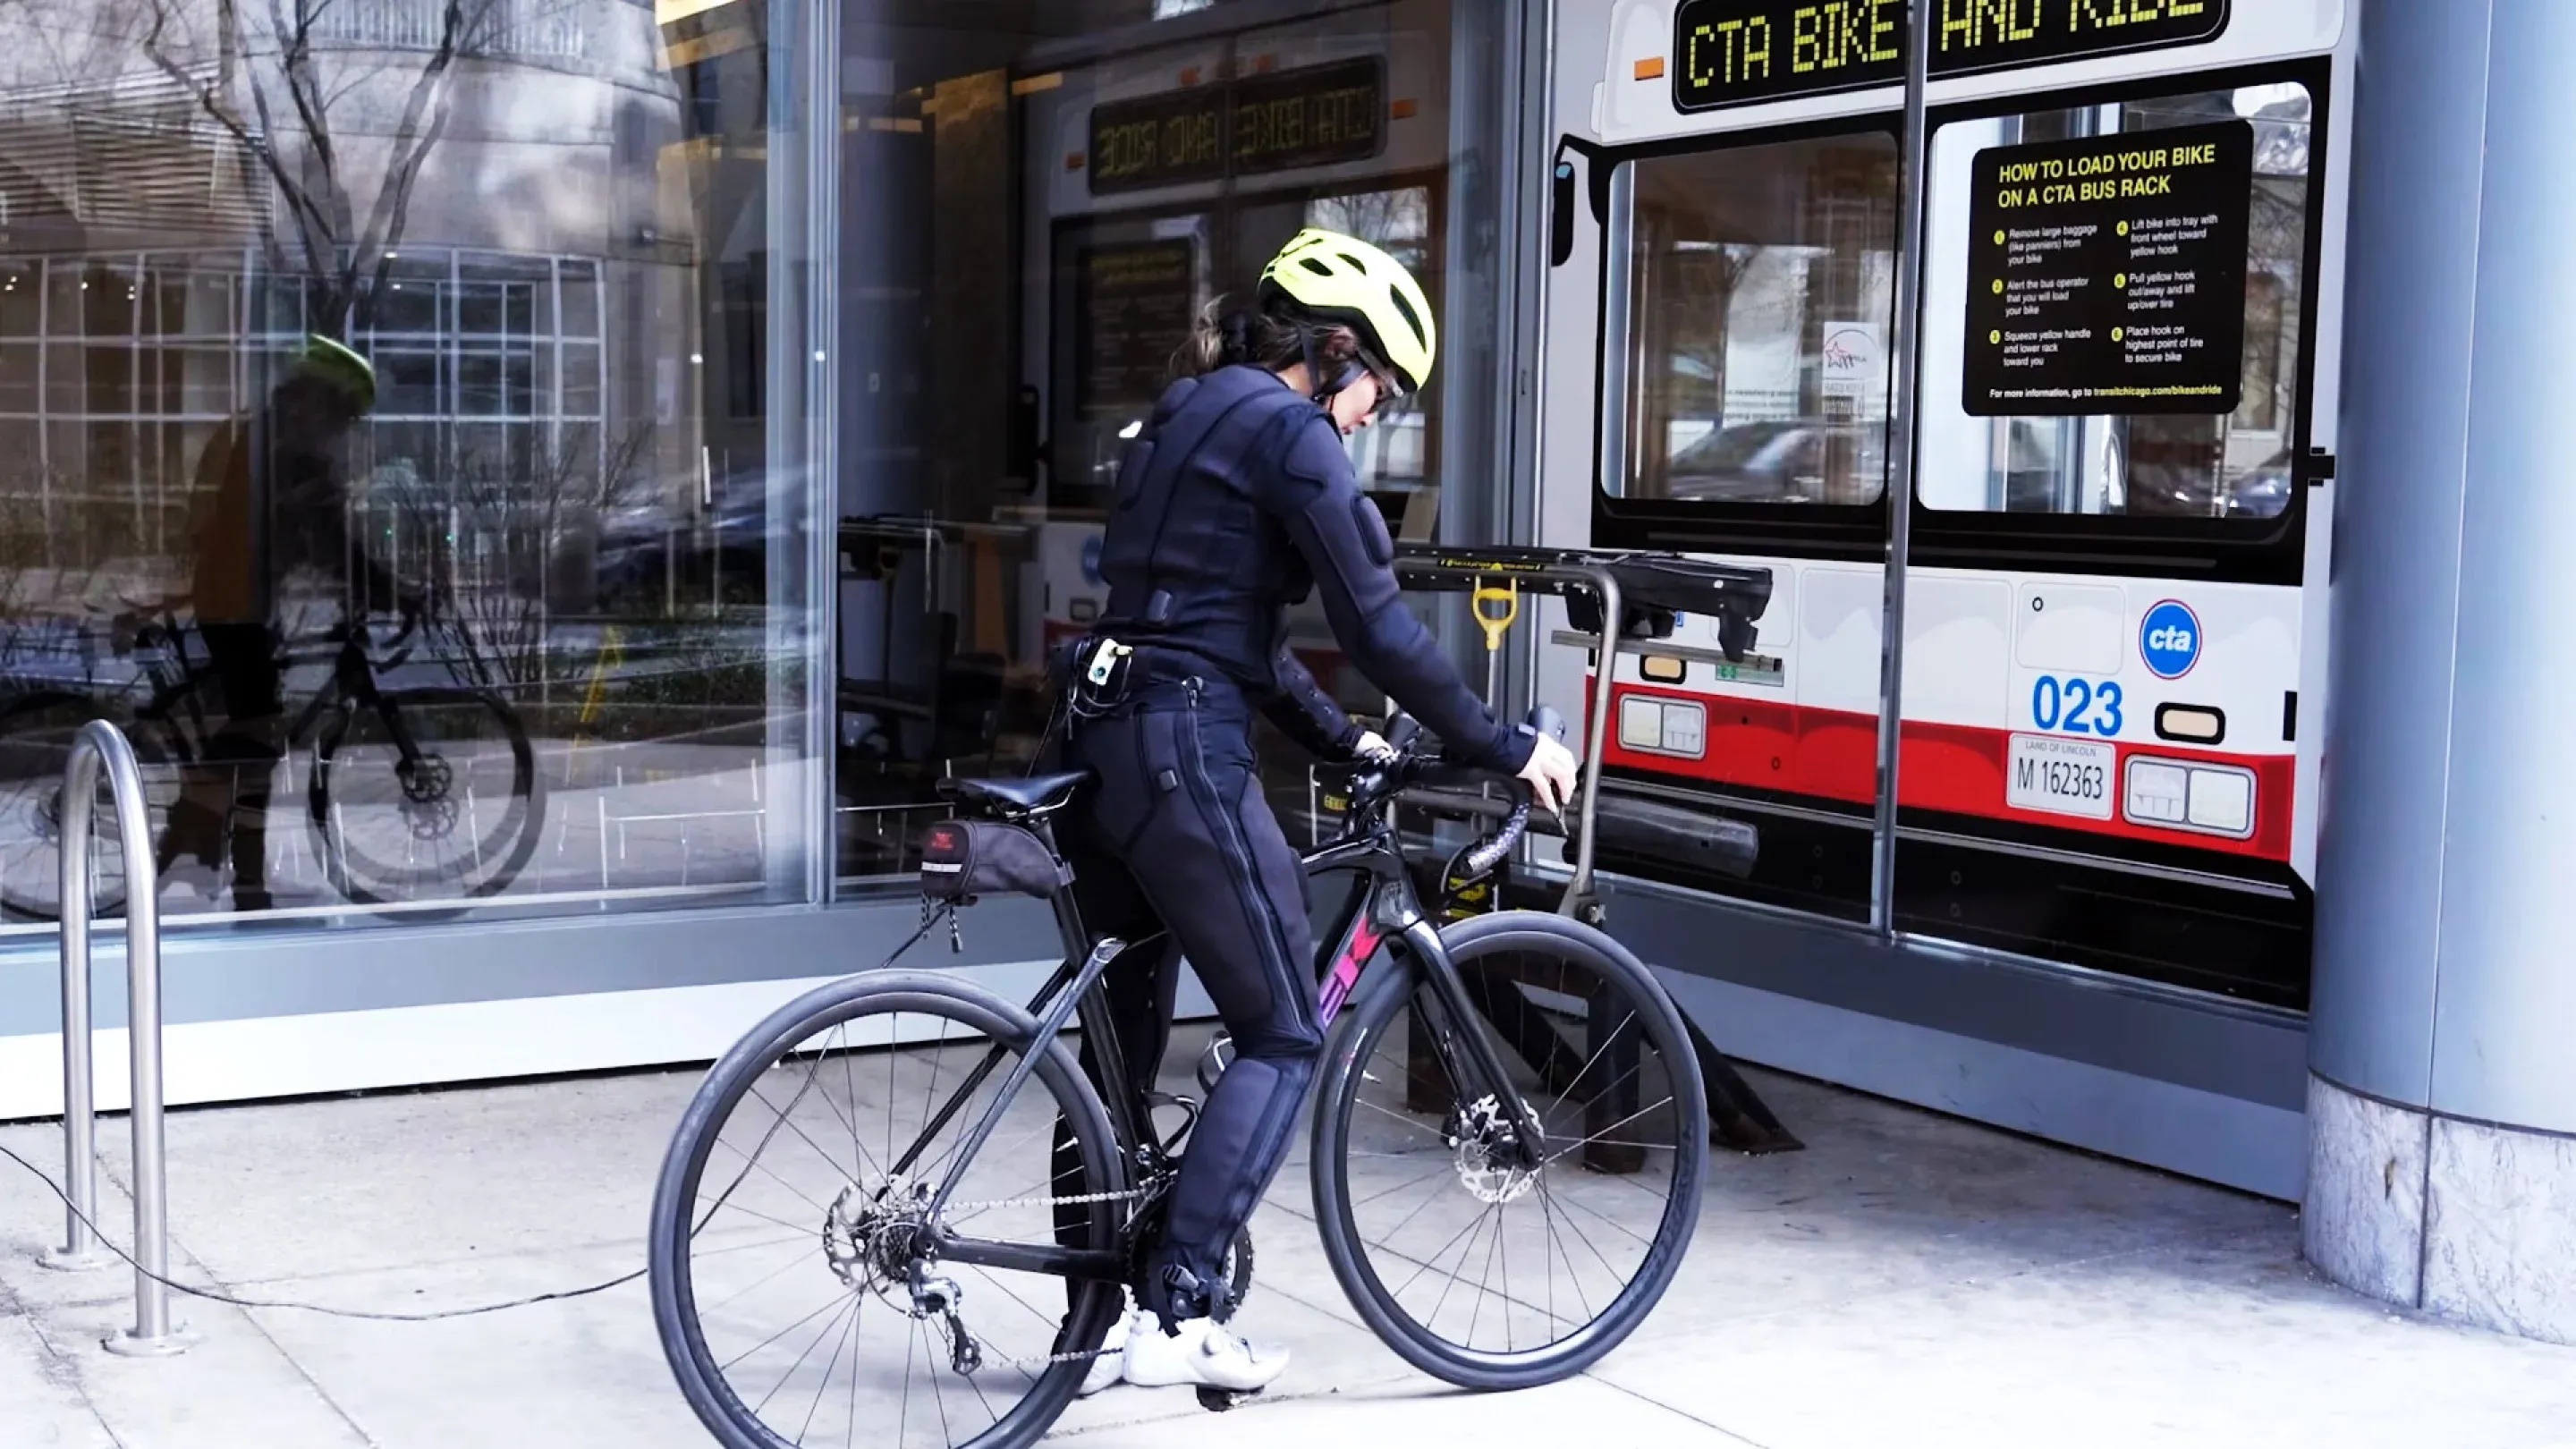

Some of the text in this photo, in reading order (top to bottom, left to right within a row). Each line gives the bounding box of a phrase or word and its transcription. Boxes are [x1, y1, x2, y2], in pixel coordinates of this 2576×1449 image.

[1689, 15, 1770, 88] CTA
[1792, 0, 1898, 72] BIKE
[1941, 0, 2040, 51] AND
[1999, 144, 2216, 182] HOW TO LOAD YOUR BIKE
[1998, 174, 2171, 208] ON A CTA BUS RACK
[2131, 214, 2218, 230] Lift bike into tray with
[2009, 225, 2097, 239] Remove large baggage
[2131, 228, 2207, 242] front wheel toward
[2063, 239, 2081, 248] from
[2130, 244, 2179, 260] yellow hook
[2007, 254, 2042, 267] your bike
[2006, 277, 2089, 290] Alert the bus operator
[2129, 269, 2196, 284] Pull yellow hook
[2166, 284, 2182, 294] and
[2184, 284, 2195, 293] lift
[2006, 290, 2069, 304] that you will load
[2159, 299, 2174, 309] tire
[2005, 305, 2039, 318] your bike
[2004, 328, 2091, 342] Squeeze yellow handle
[2126, 325, 2185, 336] Place hook on
[2004, 343, 2058, 353] and lower rack
[2125, 337, 2204, 352] highest point of tire
[2003, 357, 2045, 369] toward you
[2125, 352, 2182, 363] to secure bike
[1989, 385, 2222, 399] For more information, go to transitchicago.com/bikeandride
[2148, 624, 2191, 652] cta
[2033, 675, 2123, 736] 023
[2025, 741, 2097, 757] LAND OF LINCOLN
[2018, 757, 2103, 800] M 162363
